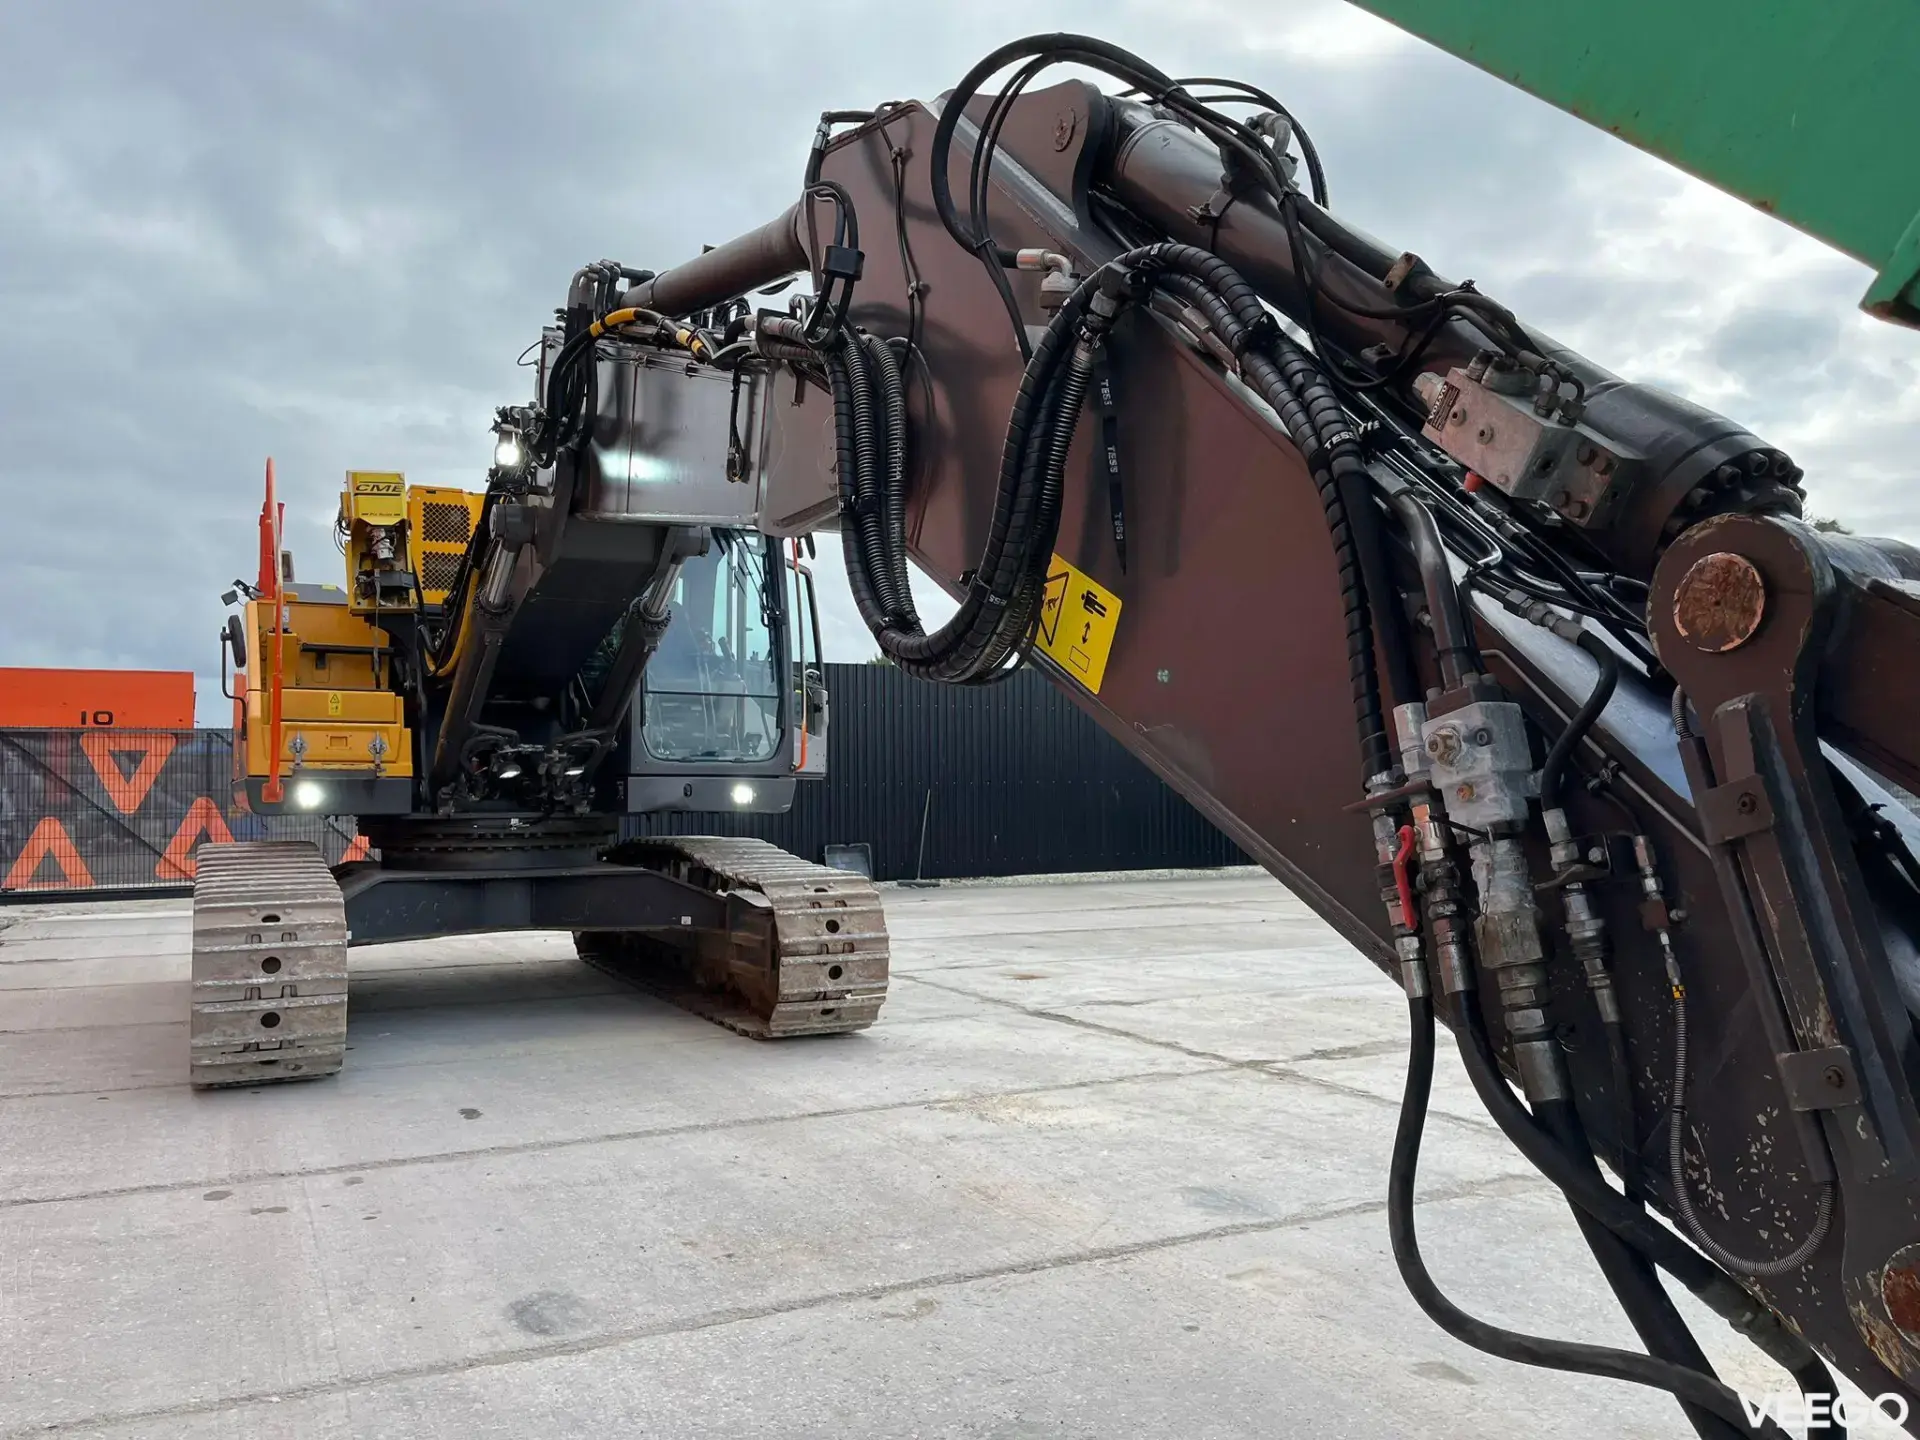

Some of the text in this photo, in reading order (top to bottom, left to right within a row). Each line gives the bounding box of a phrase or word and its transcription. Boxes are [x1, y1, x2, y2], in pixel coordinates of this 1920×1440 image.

[1428, 385, 1448, 419] VOLVO
[1107, 446, 1118, 473] TESS
[1114, 512, 1124, 540] TESS
